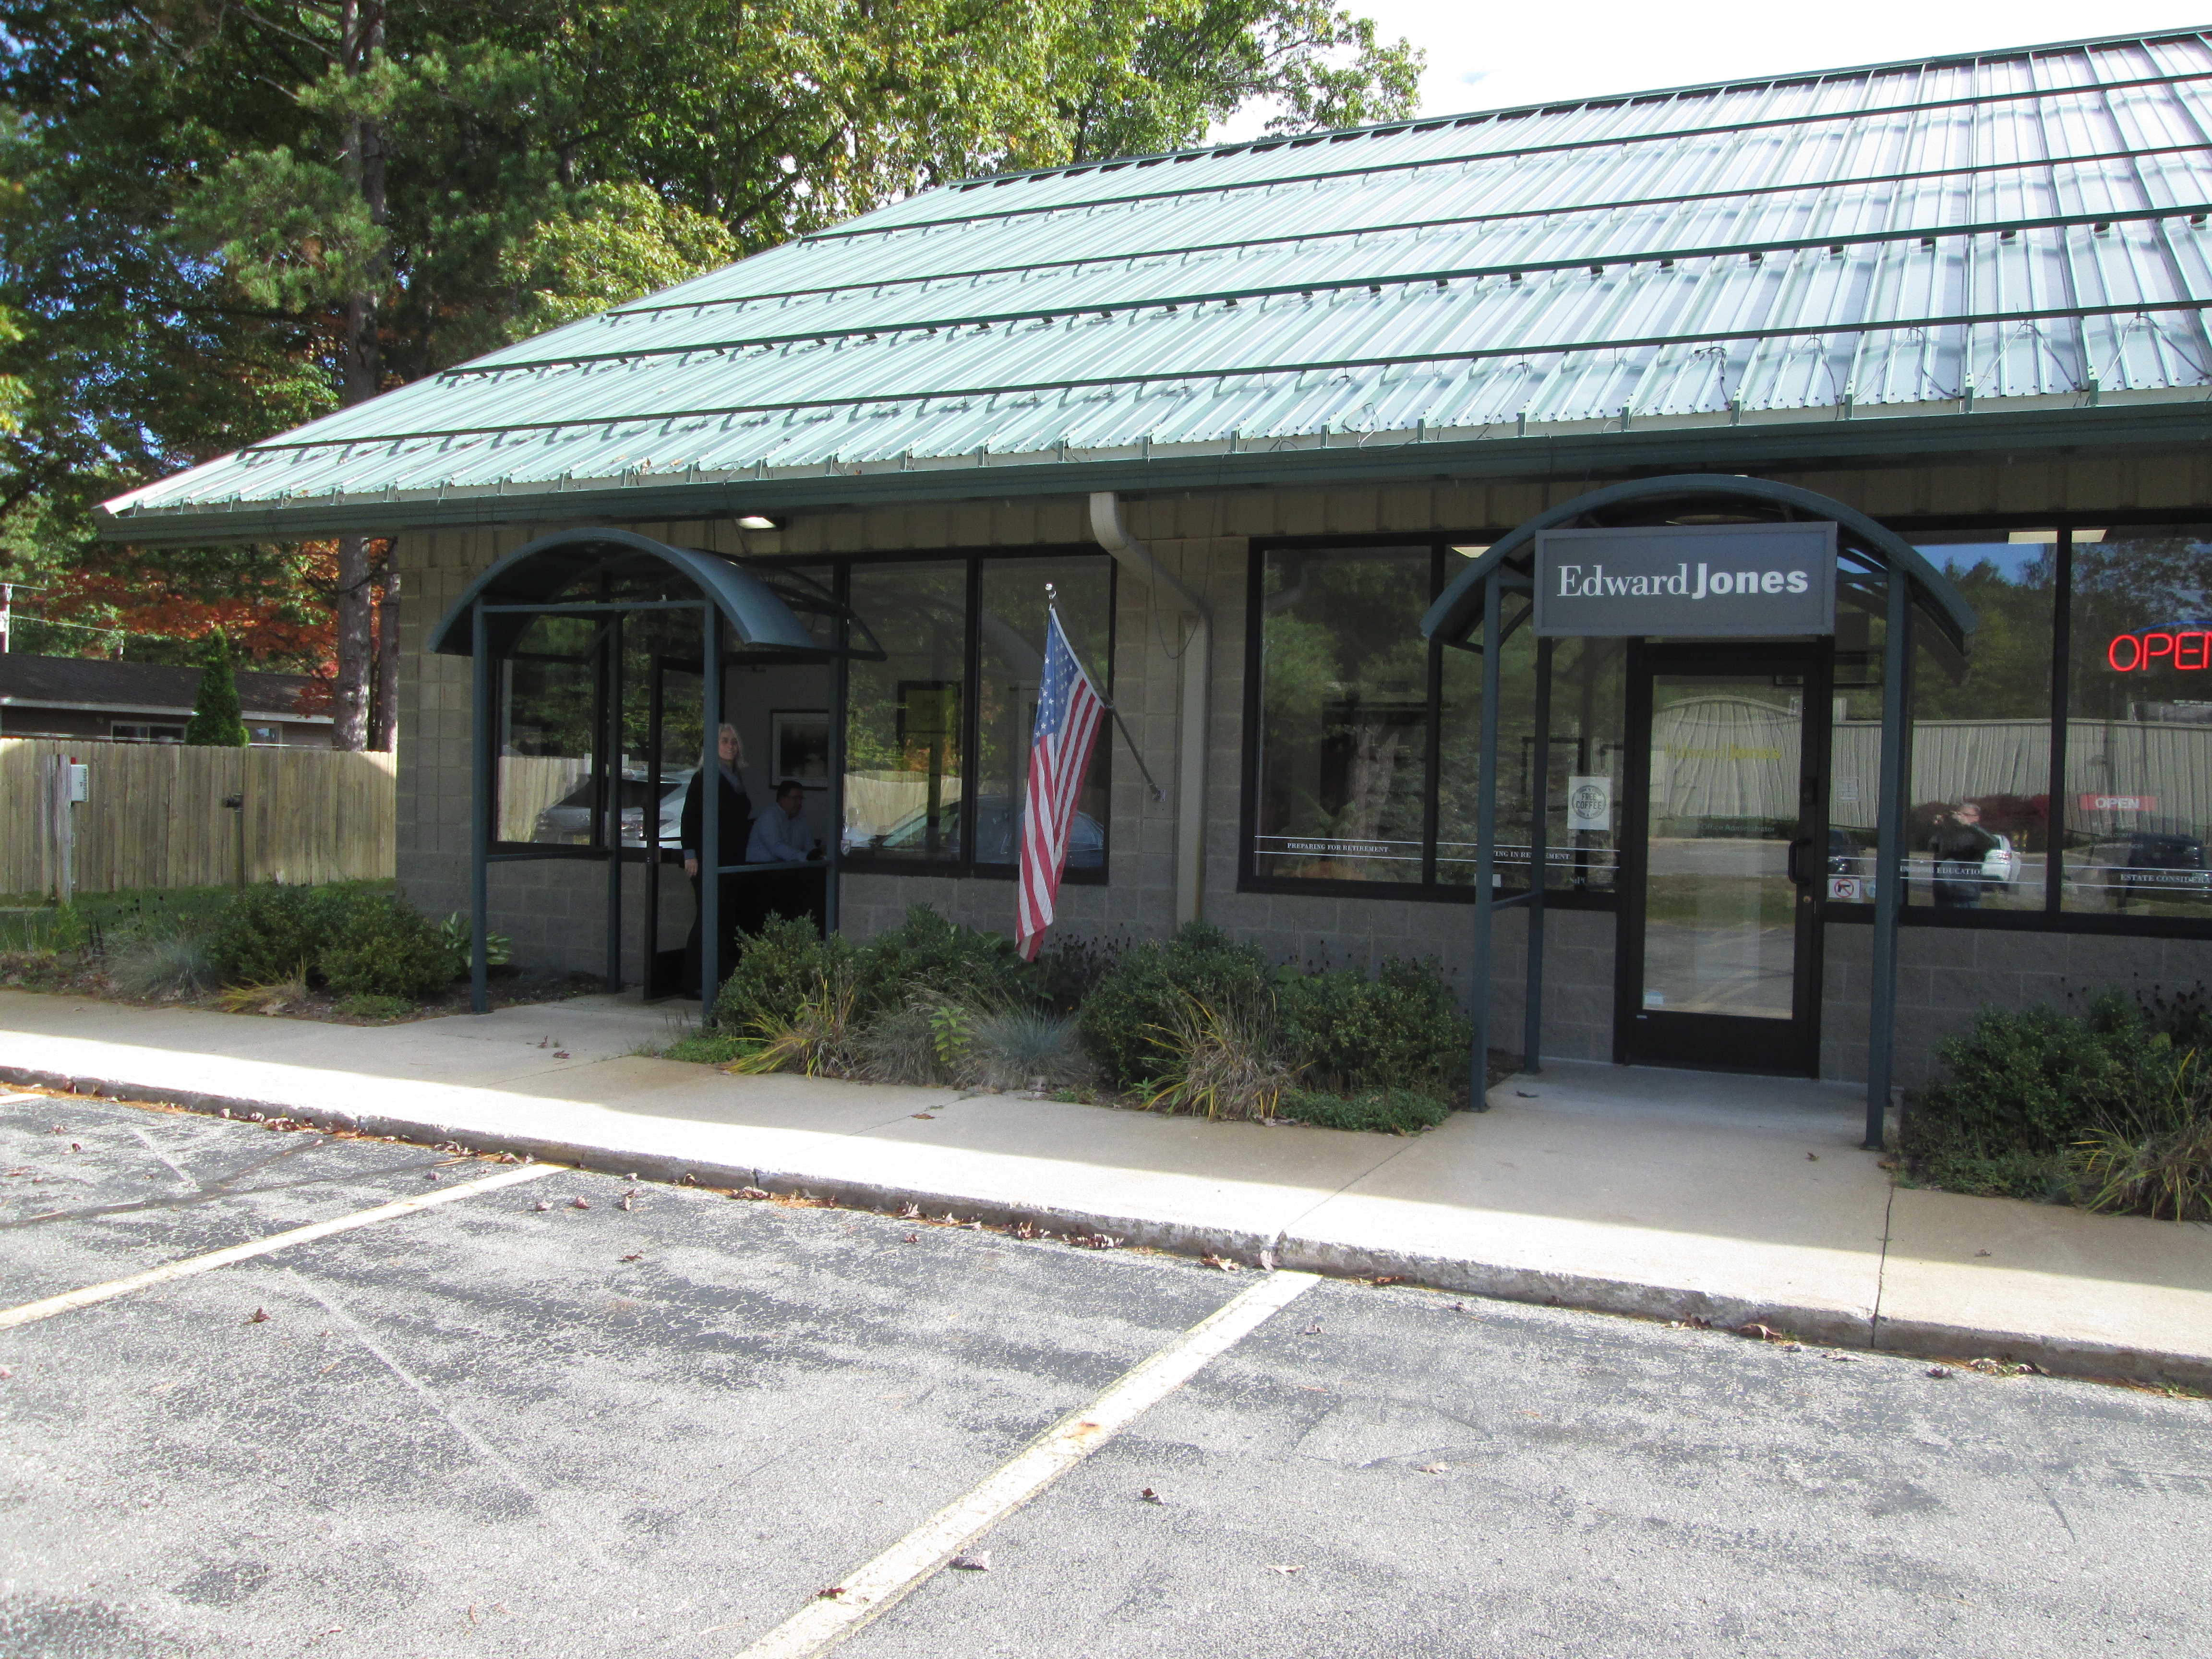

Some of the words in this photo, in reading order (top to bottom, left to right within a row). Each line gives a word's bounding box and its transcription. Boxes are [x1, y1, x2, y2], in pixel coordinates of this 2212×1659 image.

[1581, 793, 1596, 801] FREE
[1575, 801, 1602, 810] COFFEE
[2095, 797, 2140, 809] OPEN
[2120, 874, 2155, 882] ESTATE
[2156, 875, 2212, 884] CONSIDERA
